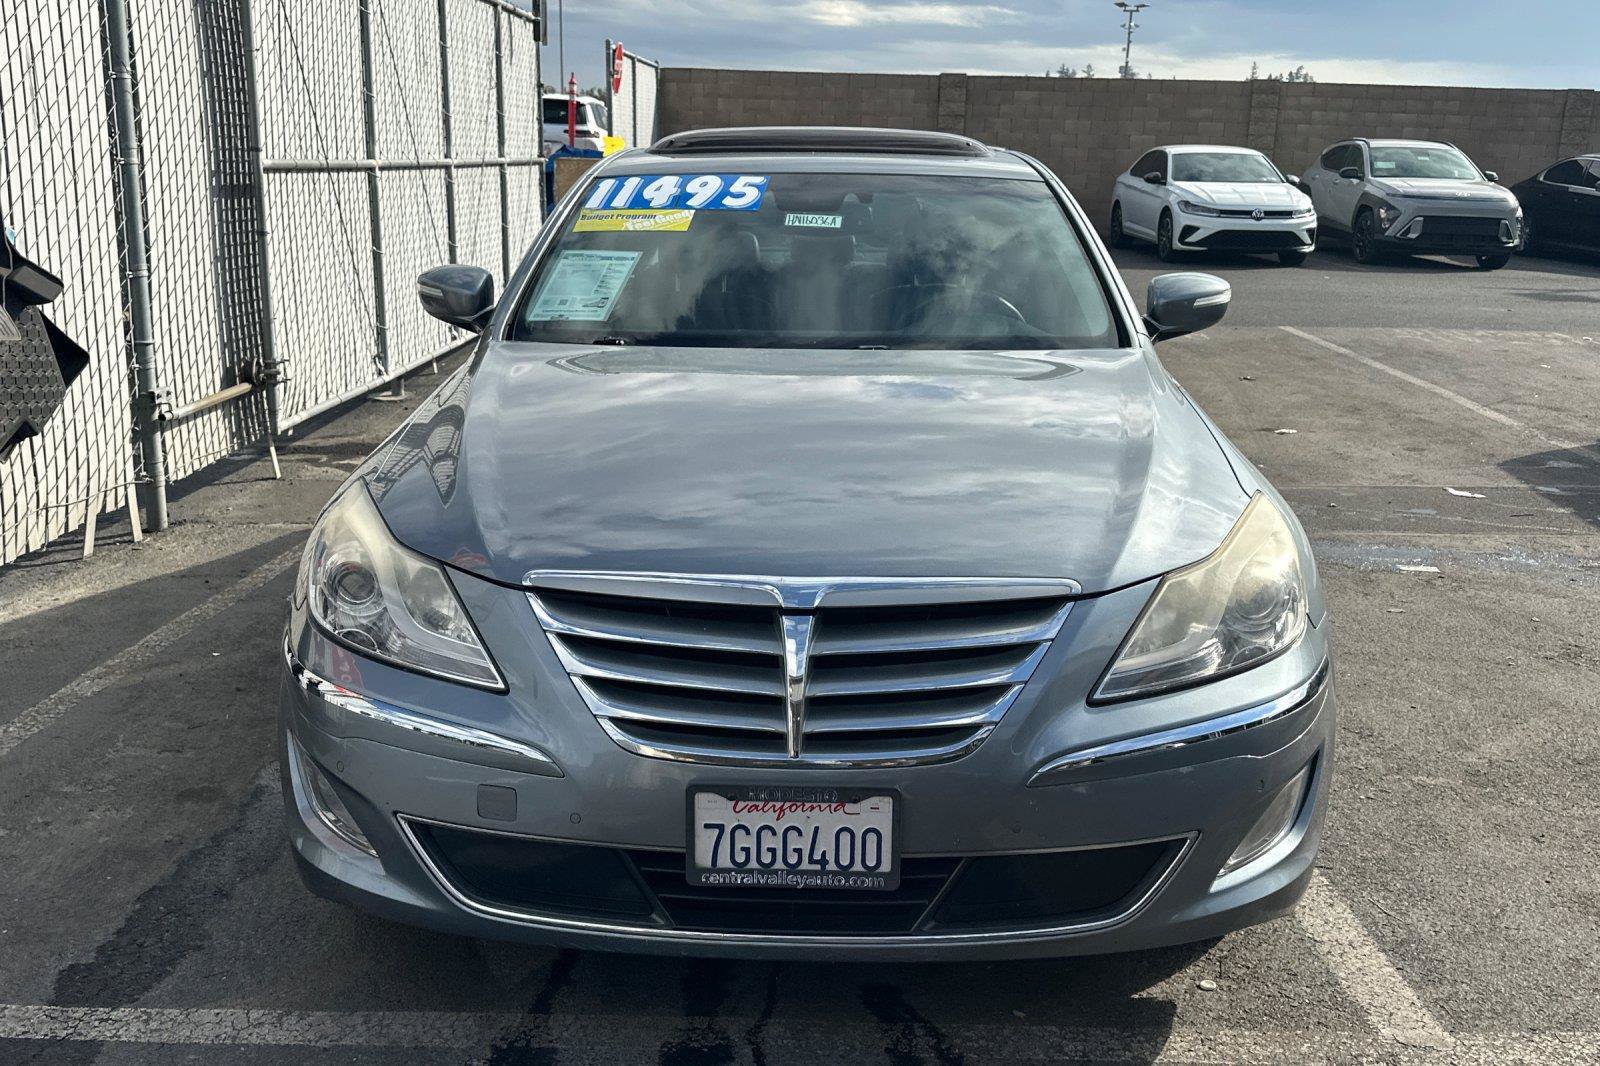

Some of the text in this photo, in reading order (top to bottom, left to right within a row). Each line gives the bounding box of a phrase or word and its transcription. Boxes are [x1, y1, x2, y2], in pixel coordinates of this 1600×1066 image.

[584, 174, 767, 209] 11495
[580, 213, 657, 221] Budget Program
[748, 788, 839, 802] MODESTO
[732, 799, 860, 822] California
[703, 822, 883, 871] 7GGG400
[701, 869, 885, 889] centralvalleyauto.com
